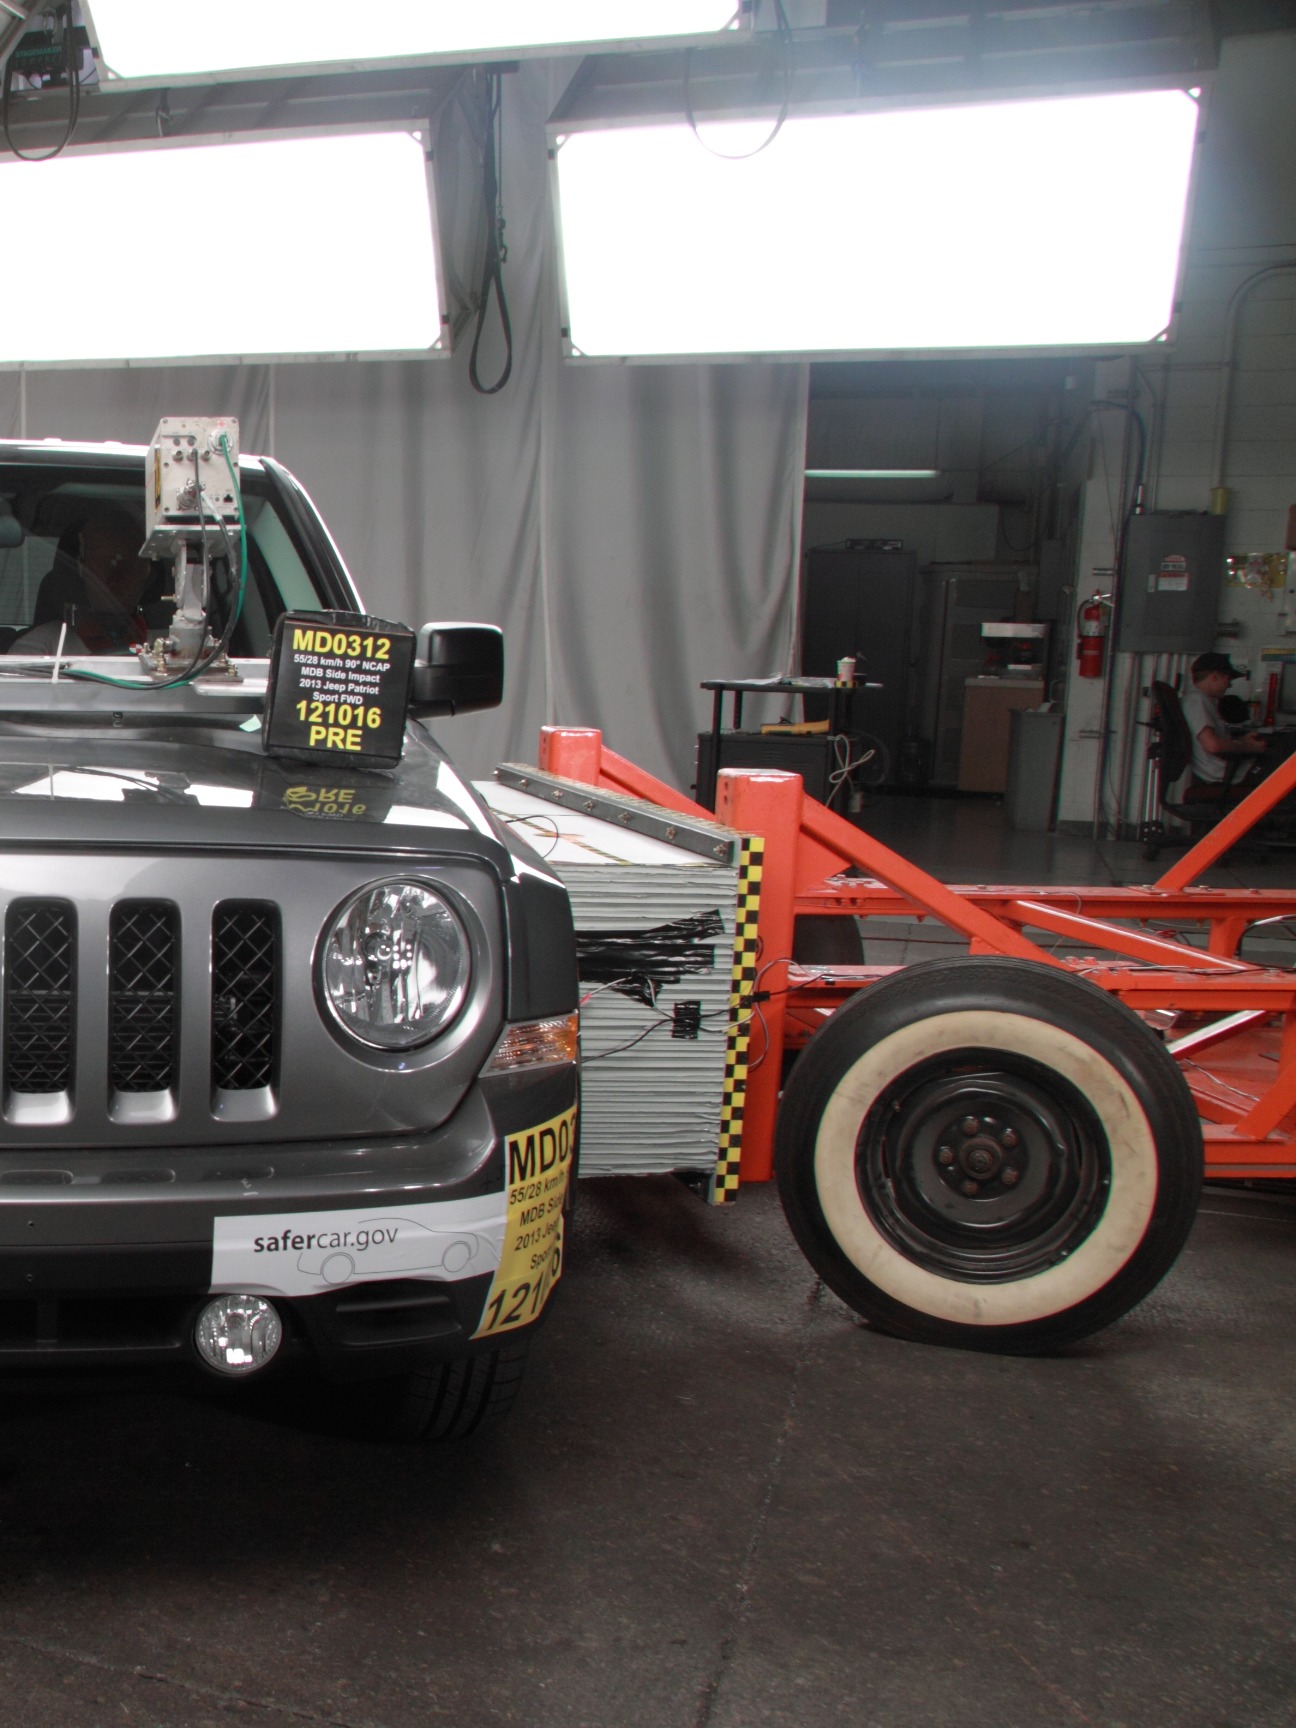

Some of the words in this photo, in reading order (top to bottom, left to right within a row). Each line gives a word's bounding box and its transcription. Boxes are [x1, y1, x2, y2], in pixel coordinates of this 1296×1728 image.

[292, 629, 391, 660] MD0312
[294, 654, 318, 665] 55/28
[320, 656, 343, 667] km/h
[362, 661, 391, 672] NCAP
[301, 666, 323, 677] MDB
[325, 668, 346, 679] Side
[348, 671, 380, 683] Impact
[299, 678, 322, 689] 2013
[323, 681, 346, 692] Jeep
[348, 683, 379, 695] Patriot
[313, 691, 338, 703] Sport
[340, 694, 363, 705] FWD
[296, 700, 382, 729] 121016
[309, 725, 363, 751] PRE
[509, 1181, 543, 1205] 55/28
[520, 1202, 545, 1227] MDB
[253, 1228, 399, 1252] safercar.gov
[514, 1227, 542, 1251] 2013
